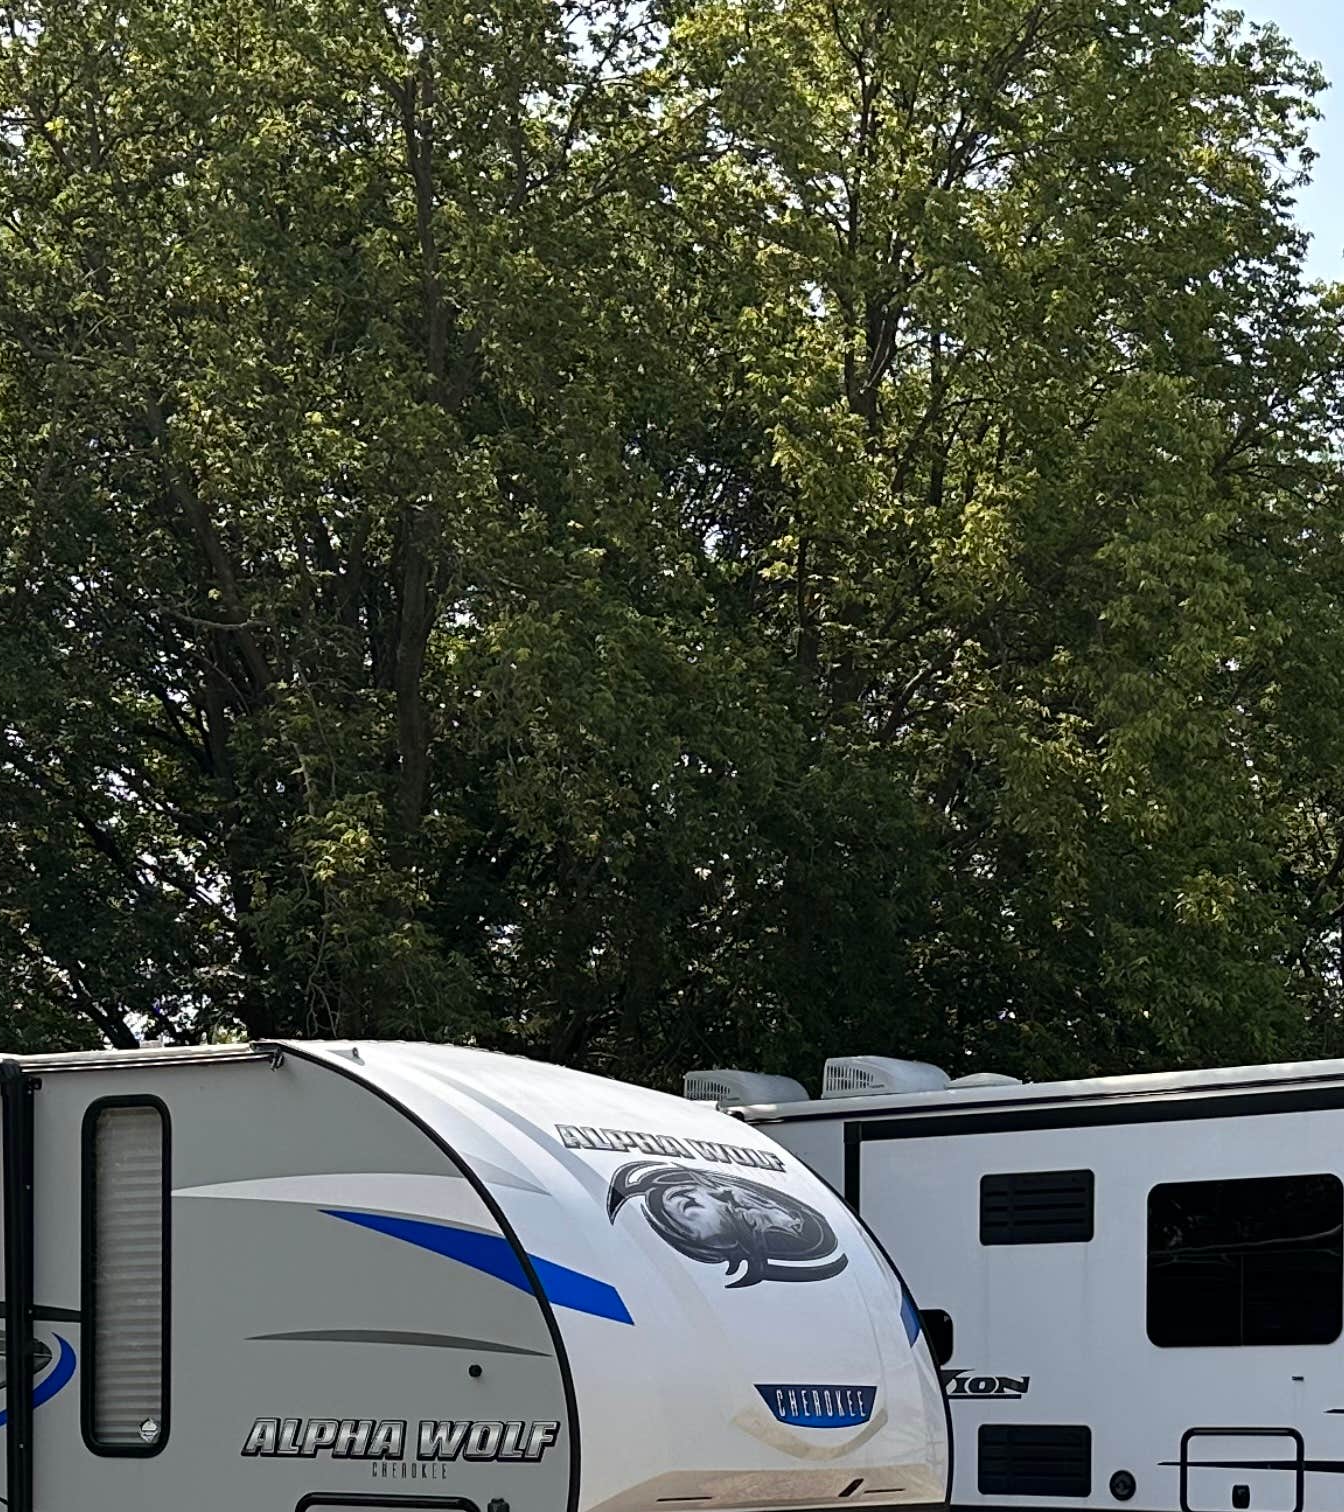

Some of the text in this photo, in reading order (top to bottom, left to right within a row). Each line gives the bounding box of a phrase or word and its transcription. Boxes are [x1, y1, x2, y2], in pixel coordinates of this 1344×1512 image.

[554, 1124, 786, 1172] ALPHA WOLF
[776, 1389, 866, 1417] CHEROKEE
[241, 1418, 560, 1462] ALPHA WOLF
[371, 1463, 448, 1480] CHEROKEE
